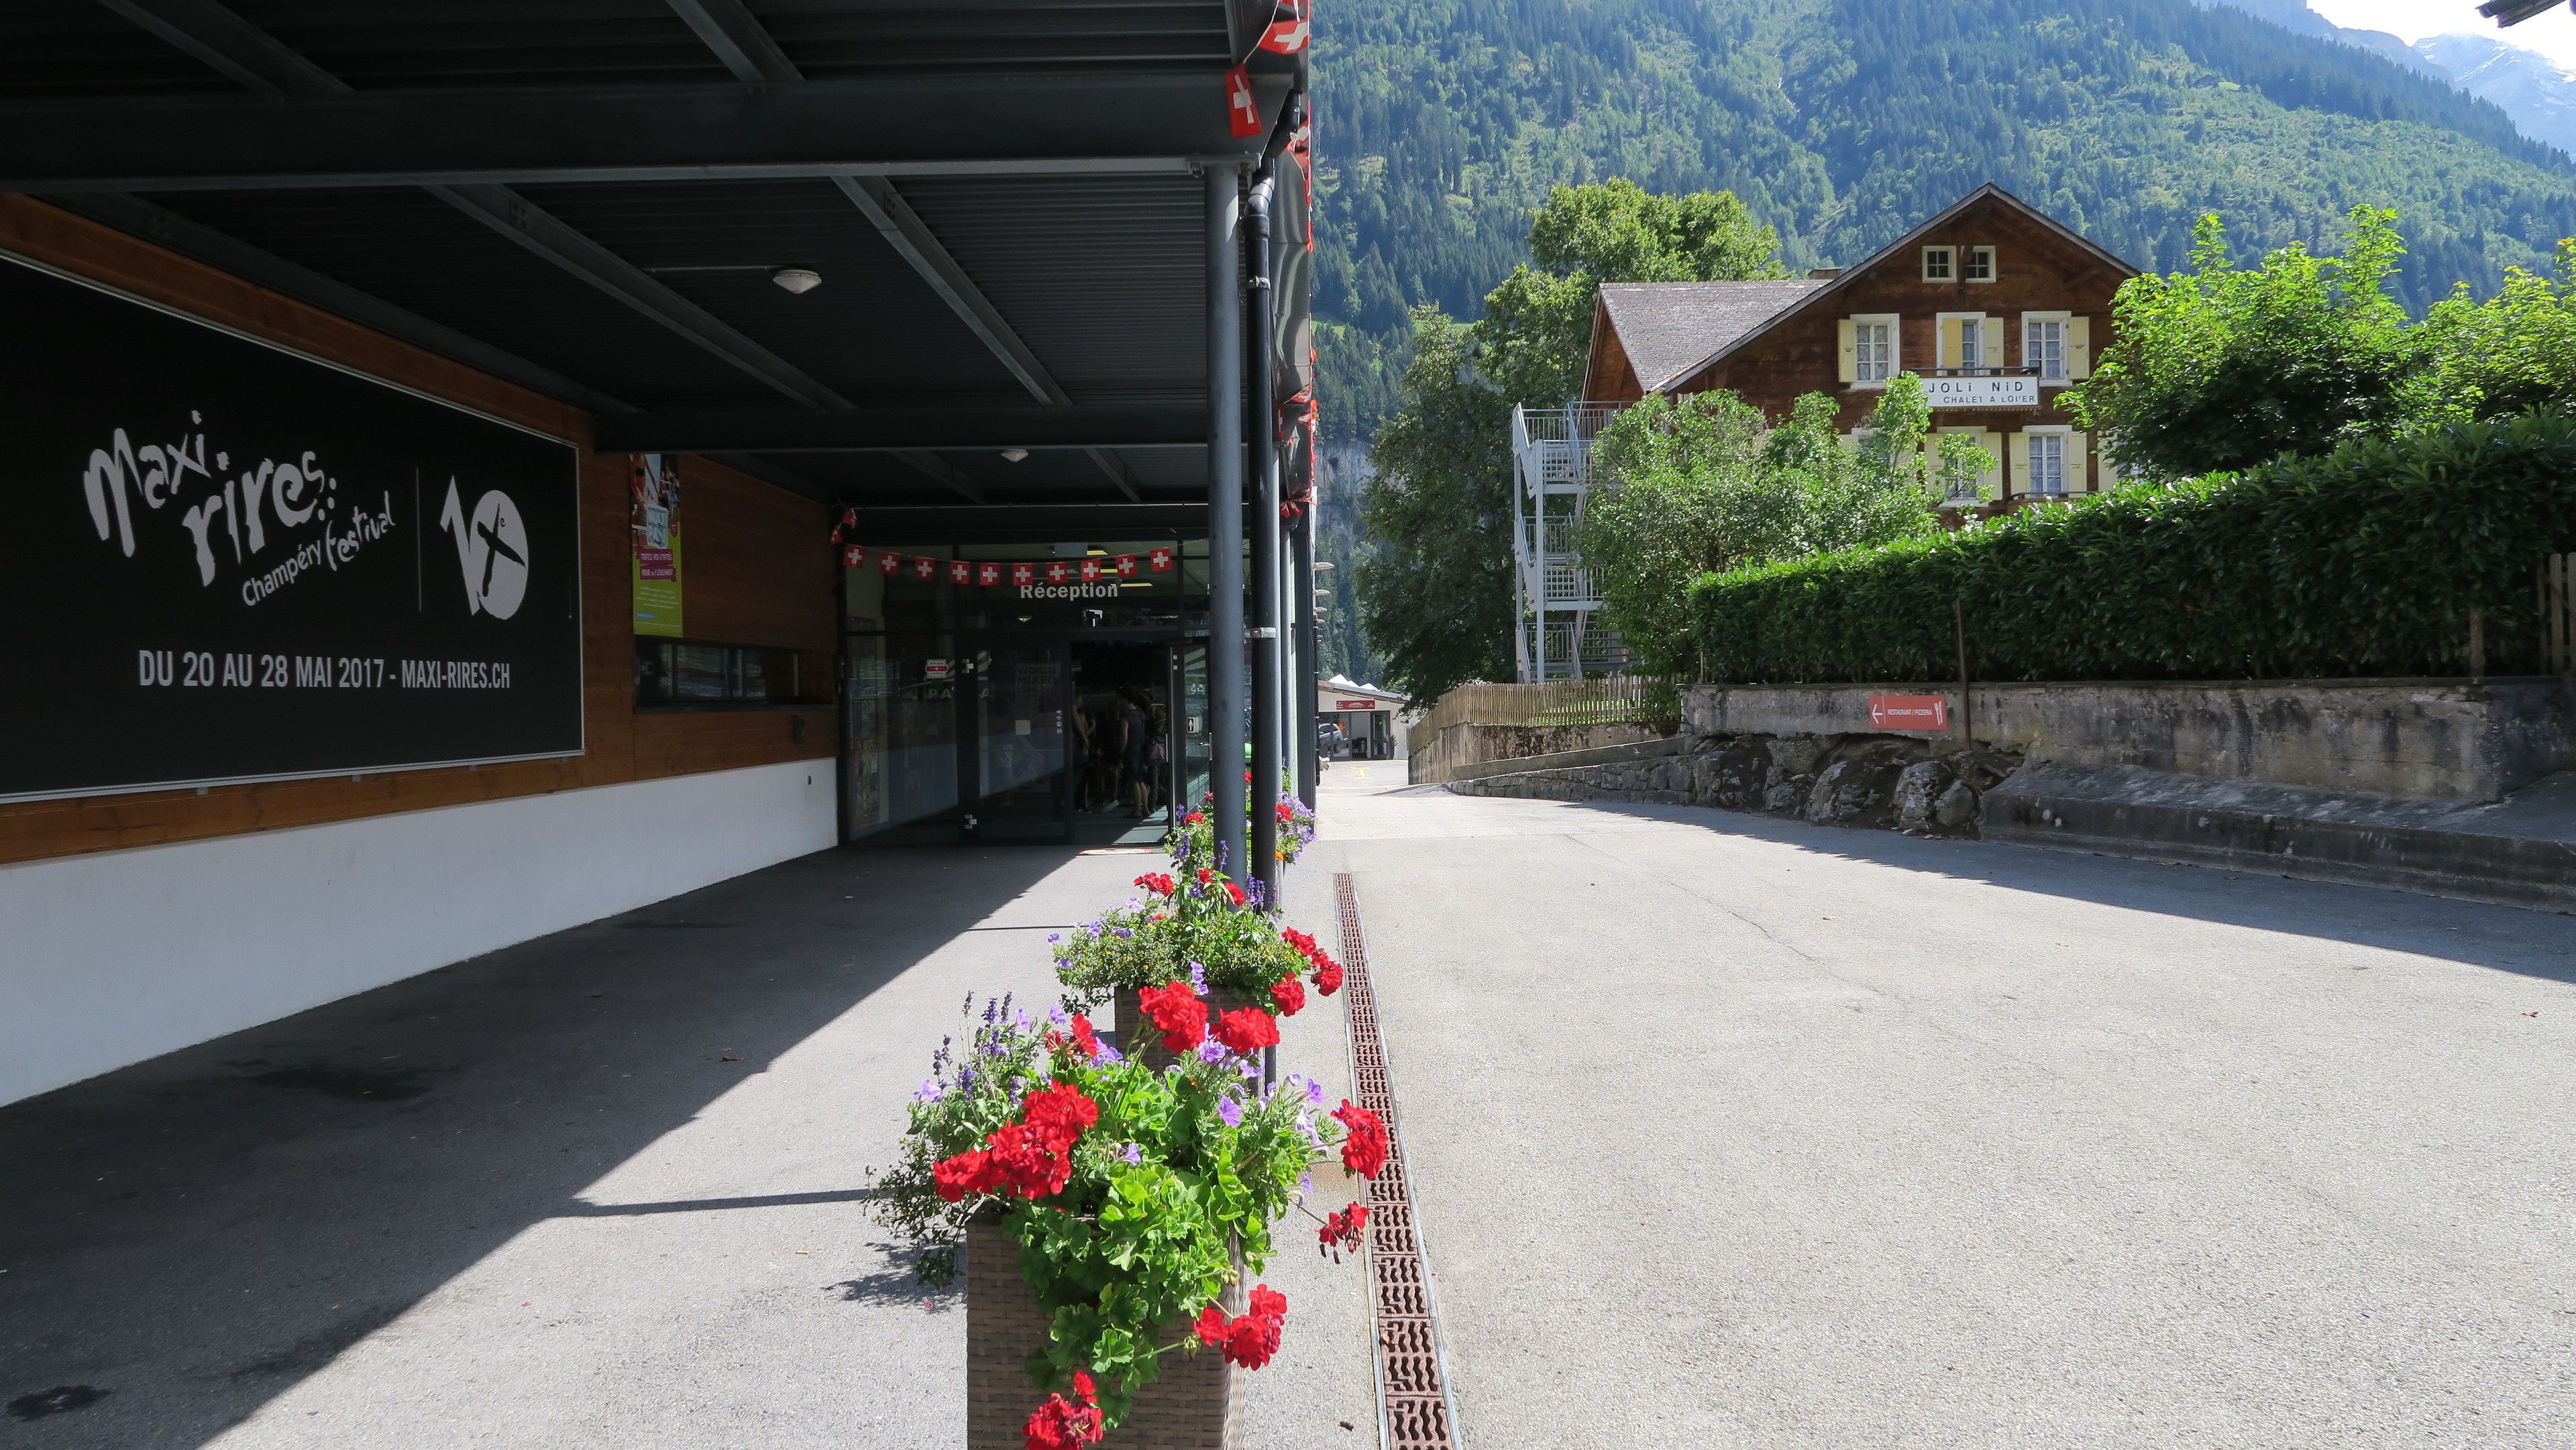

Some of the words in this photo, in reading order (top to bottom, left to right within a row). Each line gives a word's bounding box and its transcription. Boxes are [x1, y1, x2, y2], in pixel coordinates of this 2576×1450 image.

[84, 410, 212, 558] Maxi
[182, 452, 325, 588] rires
[241, 539, 321, 606] Champéry
[1020, 582, 1118, 601] Réception
[139, 650, 174, 686] DU
[183, 652, 215, 687] 20
[222, 653, 253, 687] AU
[260, 655, 288, 688] 28
[295, 656, 332, 688] MAI
[338, 657, 384, 688] 2017
[401, 660, 510, 688] MAXI-RIRES.CH
